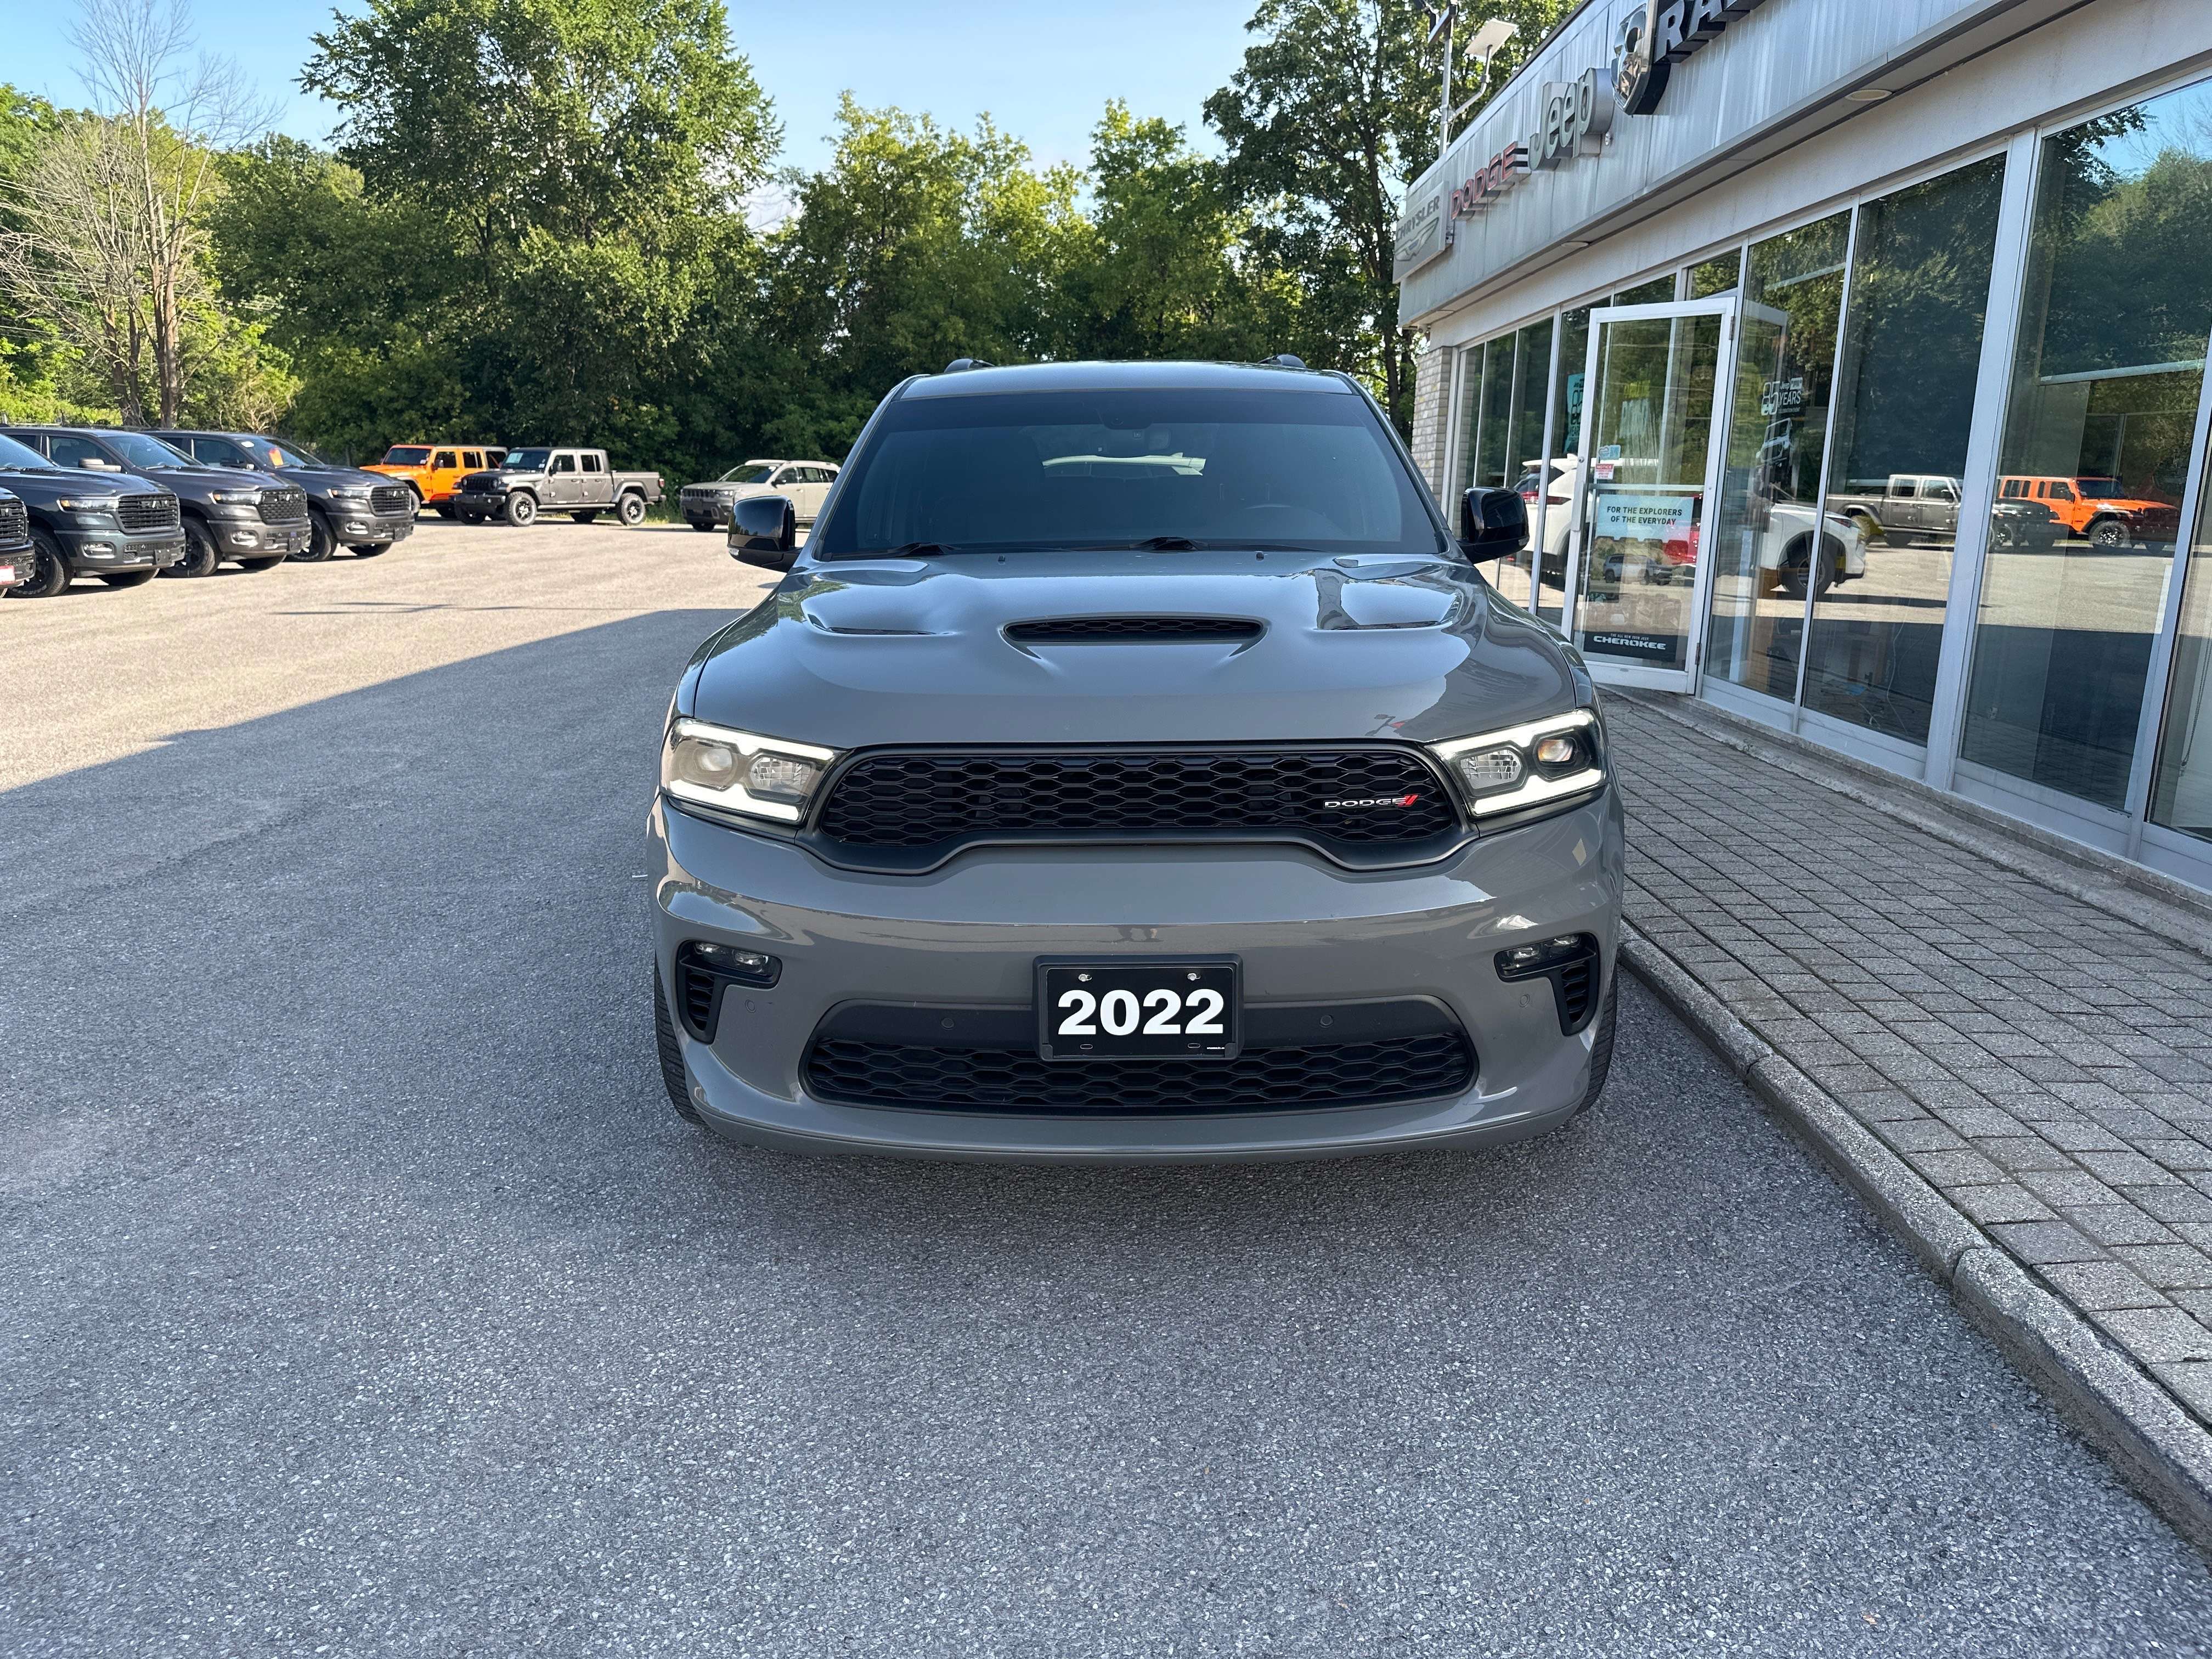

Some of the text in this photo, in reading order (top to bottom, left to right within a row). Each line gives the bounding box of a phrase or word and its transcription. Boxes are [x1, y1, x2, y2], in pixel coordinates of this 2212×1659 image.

[1654, 0, 1739, 64] RA
[1528, 67, 1597, 171] Jeep
[1451, 141, 1519, 221] DODGE
[1397, 195, 1440, 242] CHRYSLER
[1761, 381, 1802, 416] 85 YEARS
[1638, 517, 1676, 525] EVERYDAY
[1639, 507, 1683, 516] EXPLORERS
[1593, 635, 1666, 650] CHEROKEE
[1324, 798, 1407, 808] DODGE
[1057, 989, 1224, 1036] 2022
